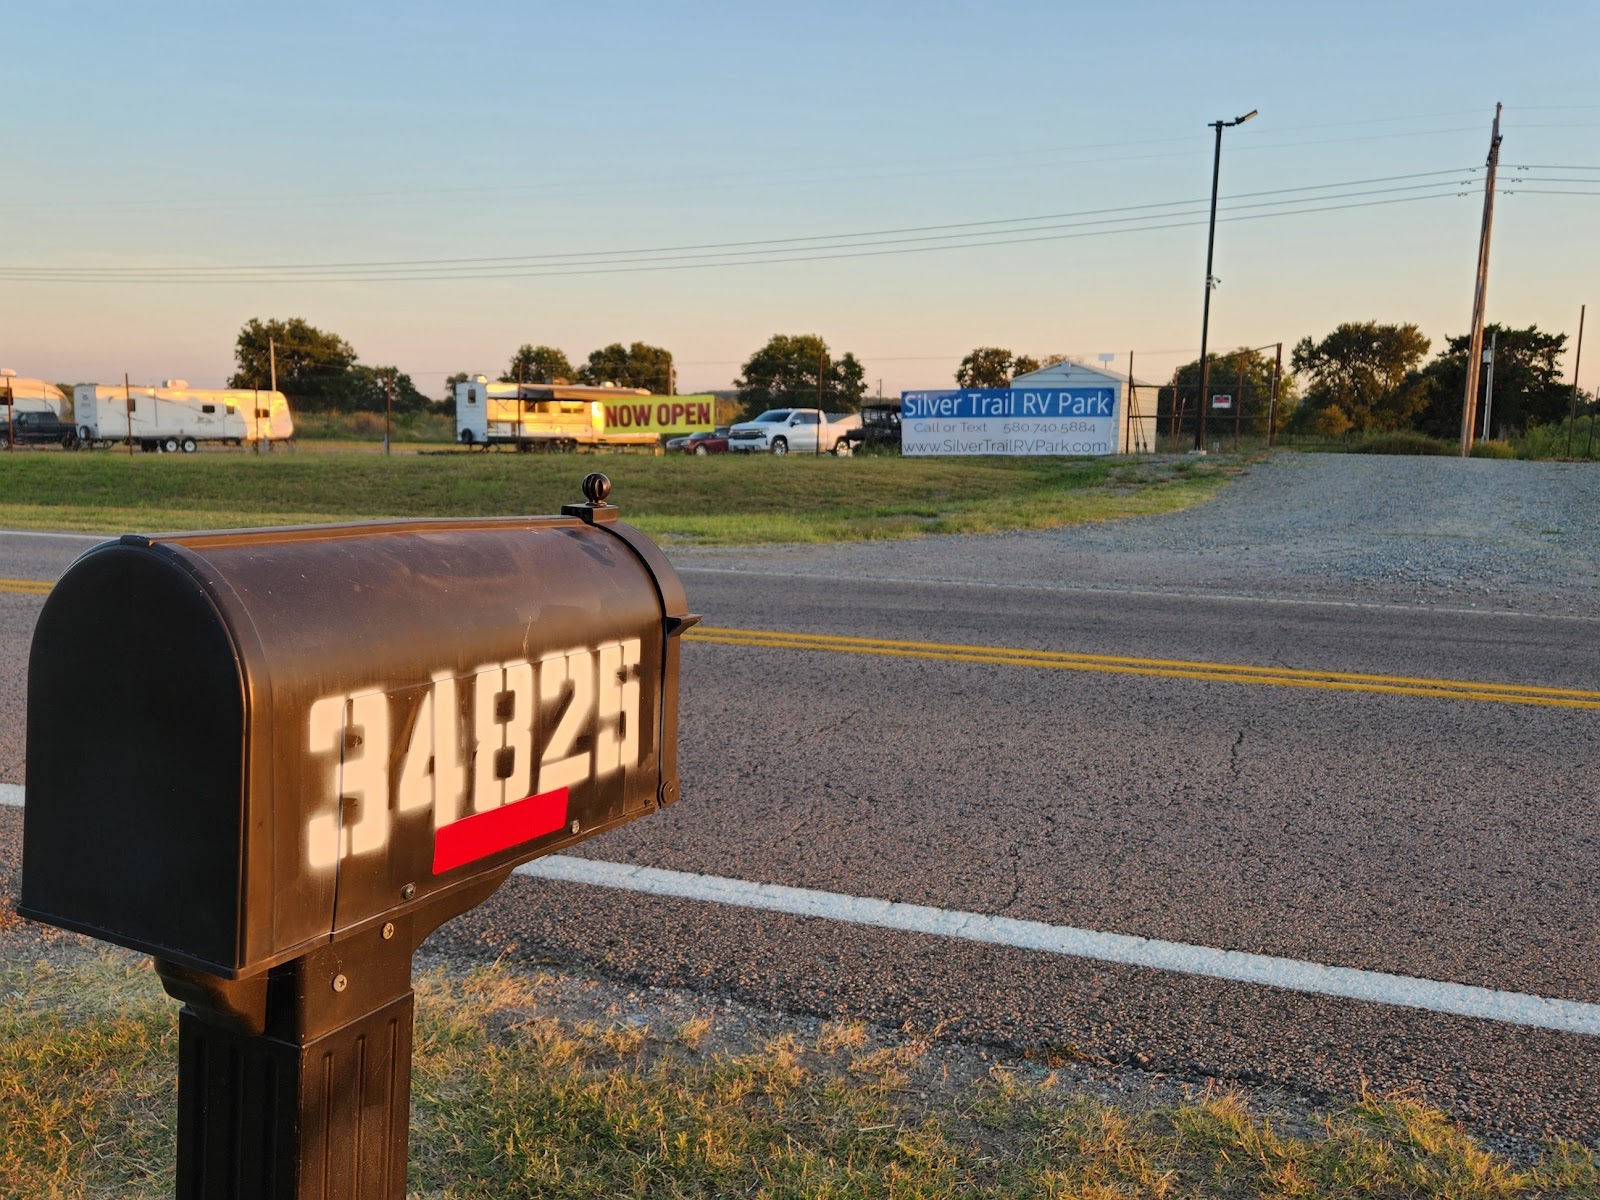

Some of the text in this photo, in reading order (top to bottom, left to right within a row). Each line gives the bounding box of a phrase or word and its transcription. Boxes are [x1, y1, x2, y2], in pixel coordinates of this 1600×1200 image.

[605, 402, 711, 427] NOW OPEN
[904, 391, 1109, 416] Silver Trail RV Park
[914, 422, 1096, 434] Call or Text 580.740.5884
[904, 439, 1107, 454] www.SilverTrailRVPark.com
[308, 638, 641, 868] 34825
